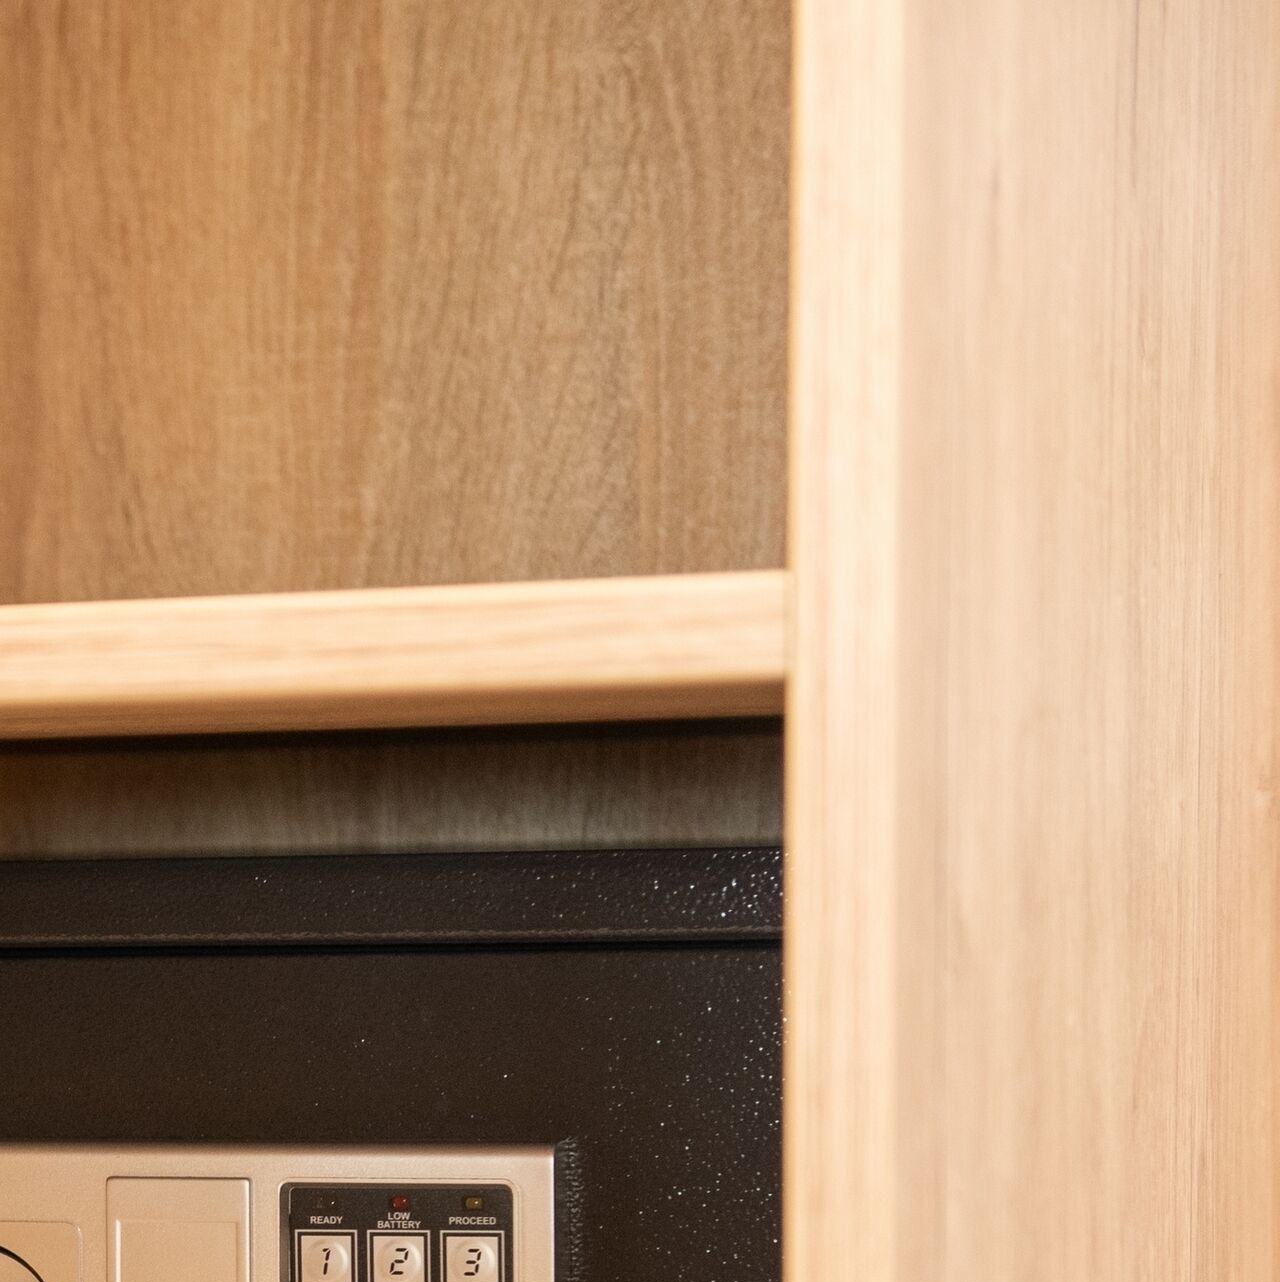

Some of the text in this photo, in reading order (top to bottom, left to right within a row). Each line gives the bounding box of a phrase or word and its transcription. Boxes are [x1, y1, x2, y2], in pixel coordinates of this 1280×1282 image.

[309, 1215, 343, 1225] READY
[387, 1212, 411, 1221] LOW
[448, 1216, 497, 1226] PROCEED
[376, 1220, 422, 1230] BATTERY
[322, 1247, 331, 1276] 1
[389, 1247, 409, 1276] 2
[463, 1248, 482, 1277] 3
